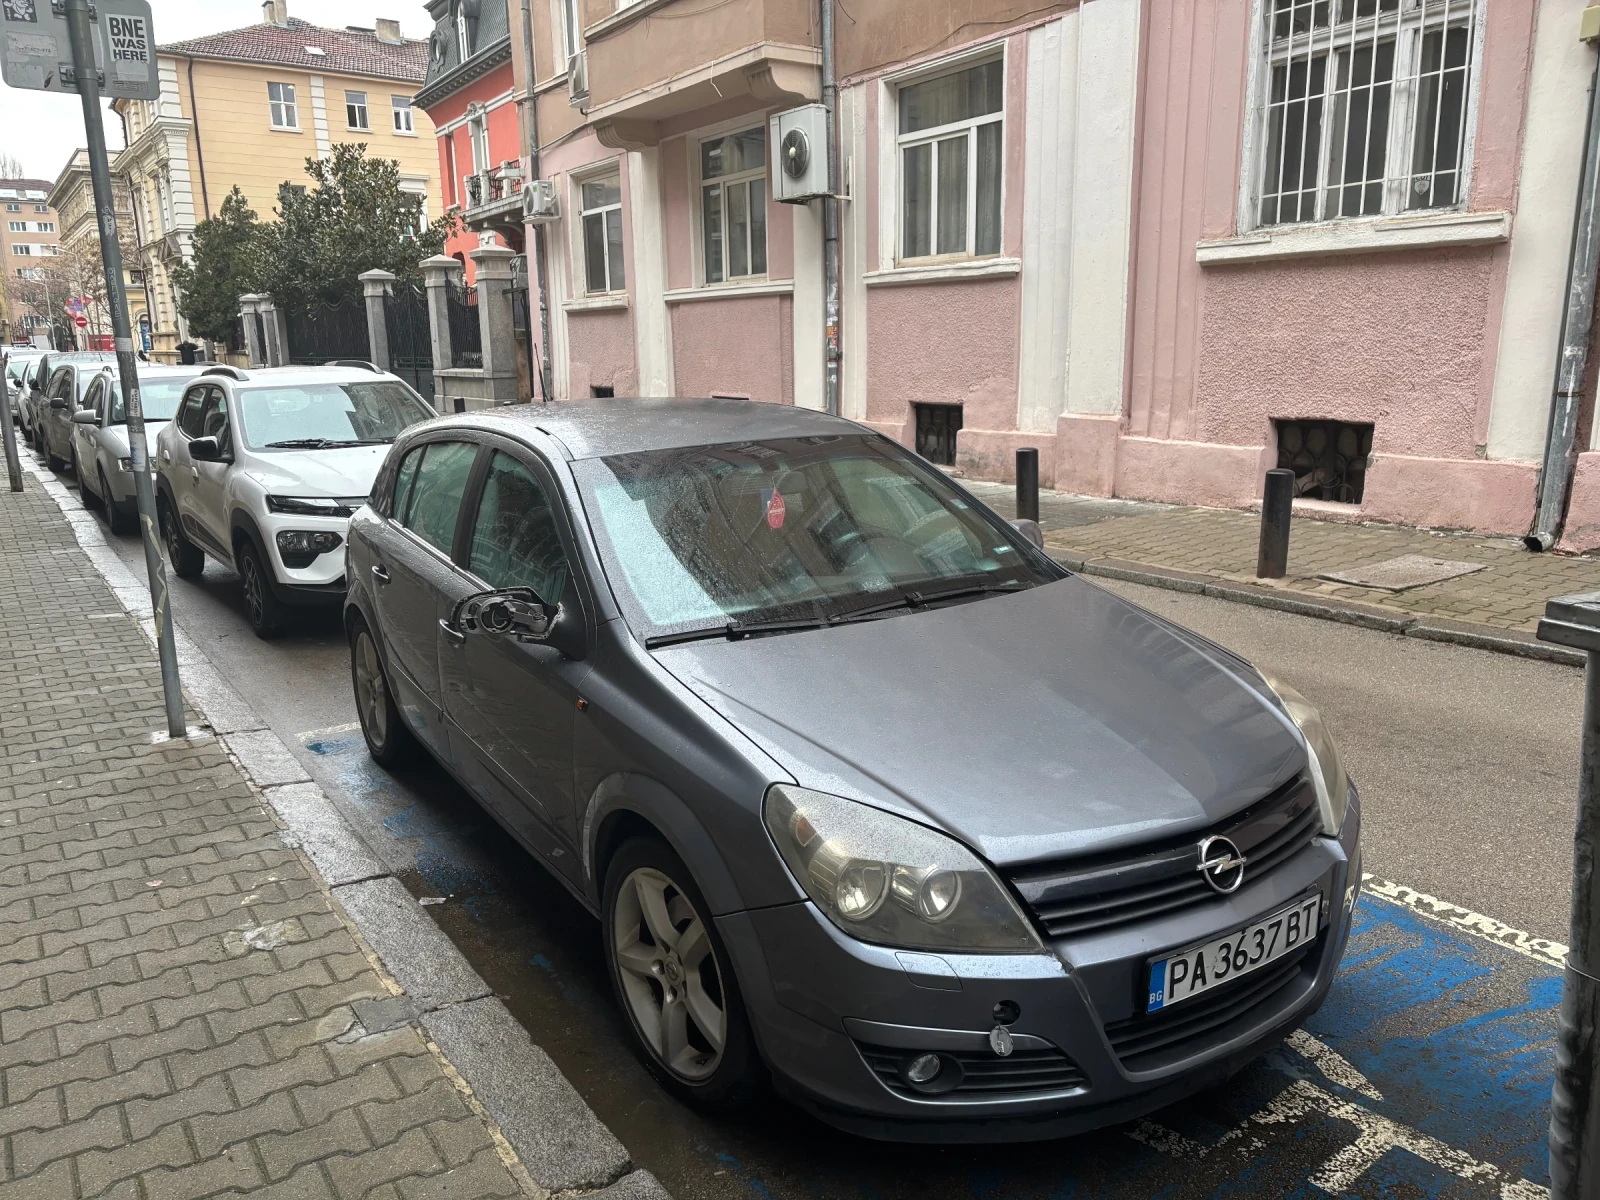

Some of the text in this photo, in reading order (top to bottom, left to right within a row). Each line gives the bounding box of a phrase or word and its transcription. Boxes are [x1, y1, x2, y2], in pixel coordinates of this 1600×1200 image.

[108, 17, 145, 38] BNE
[112, 38, 146, 50] WAS
[113, 49, 148, 61] HERE
[1168, 901, 1317, 999] PA 3637 BT
[1149, 990, 1163, 1004] BG
